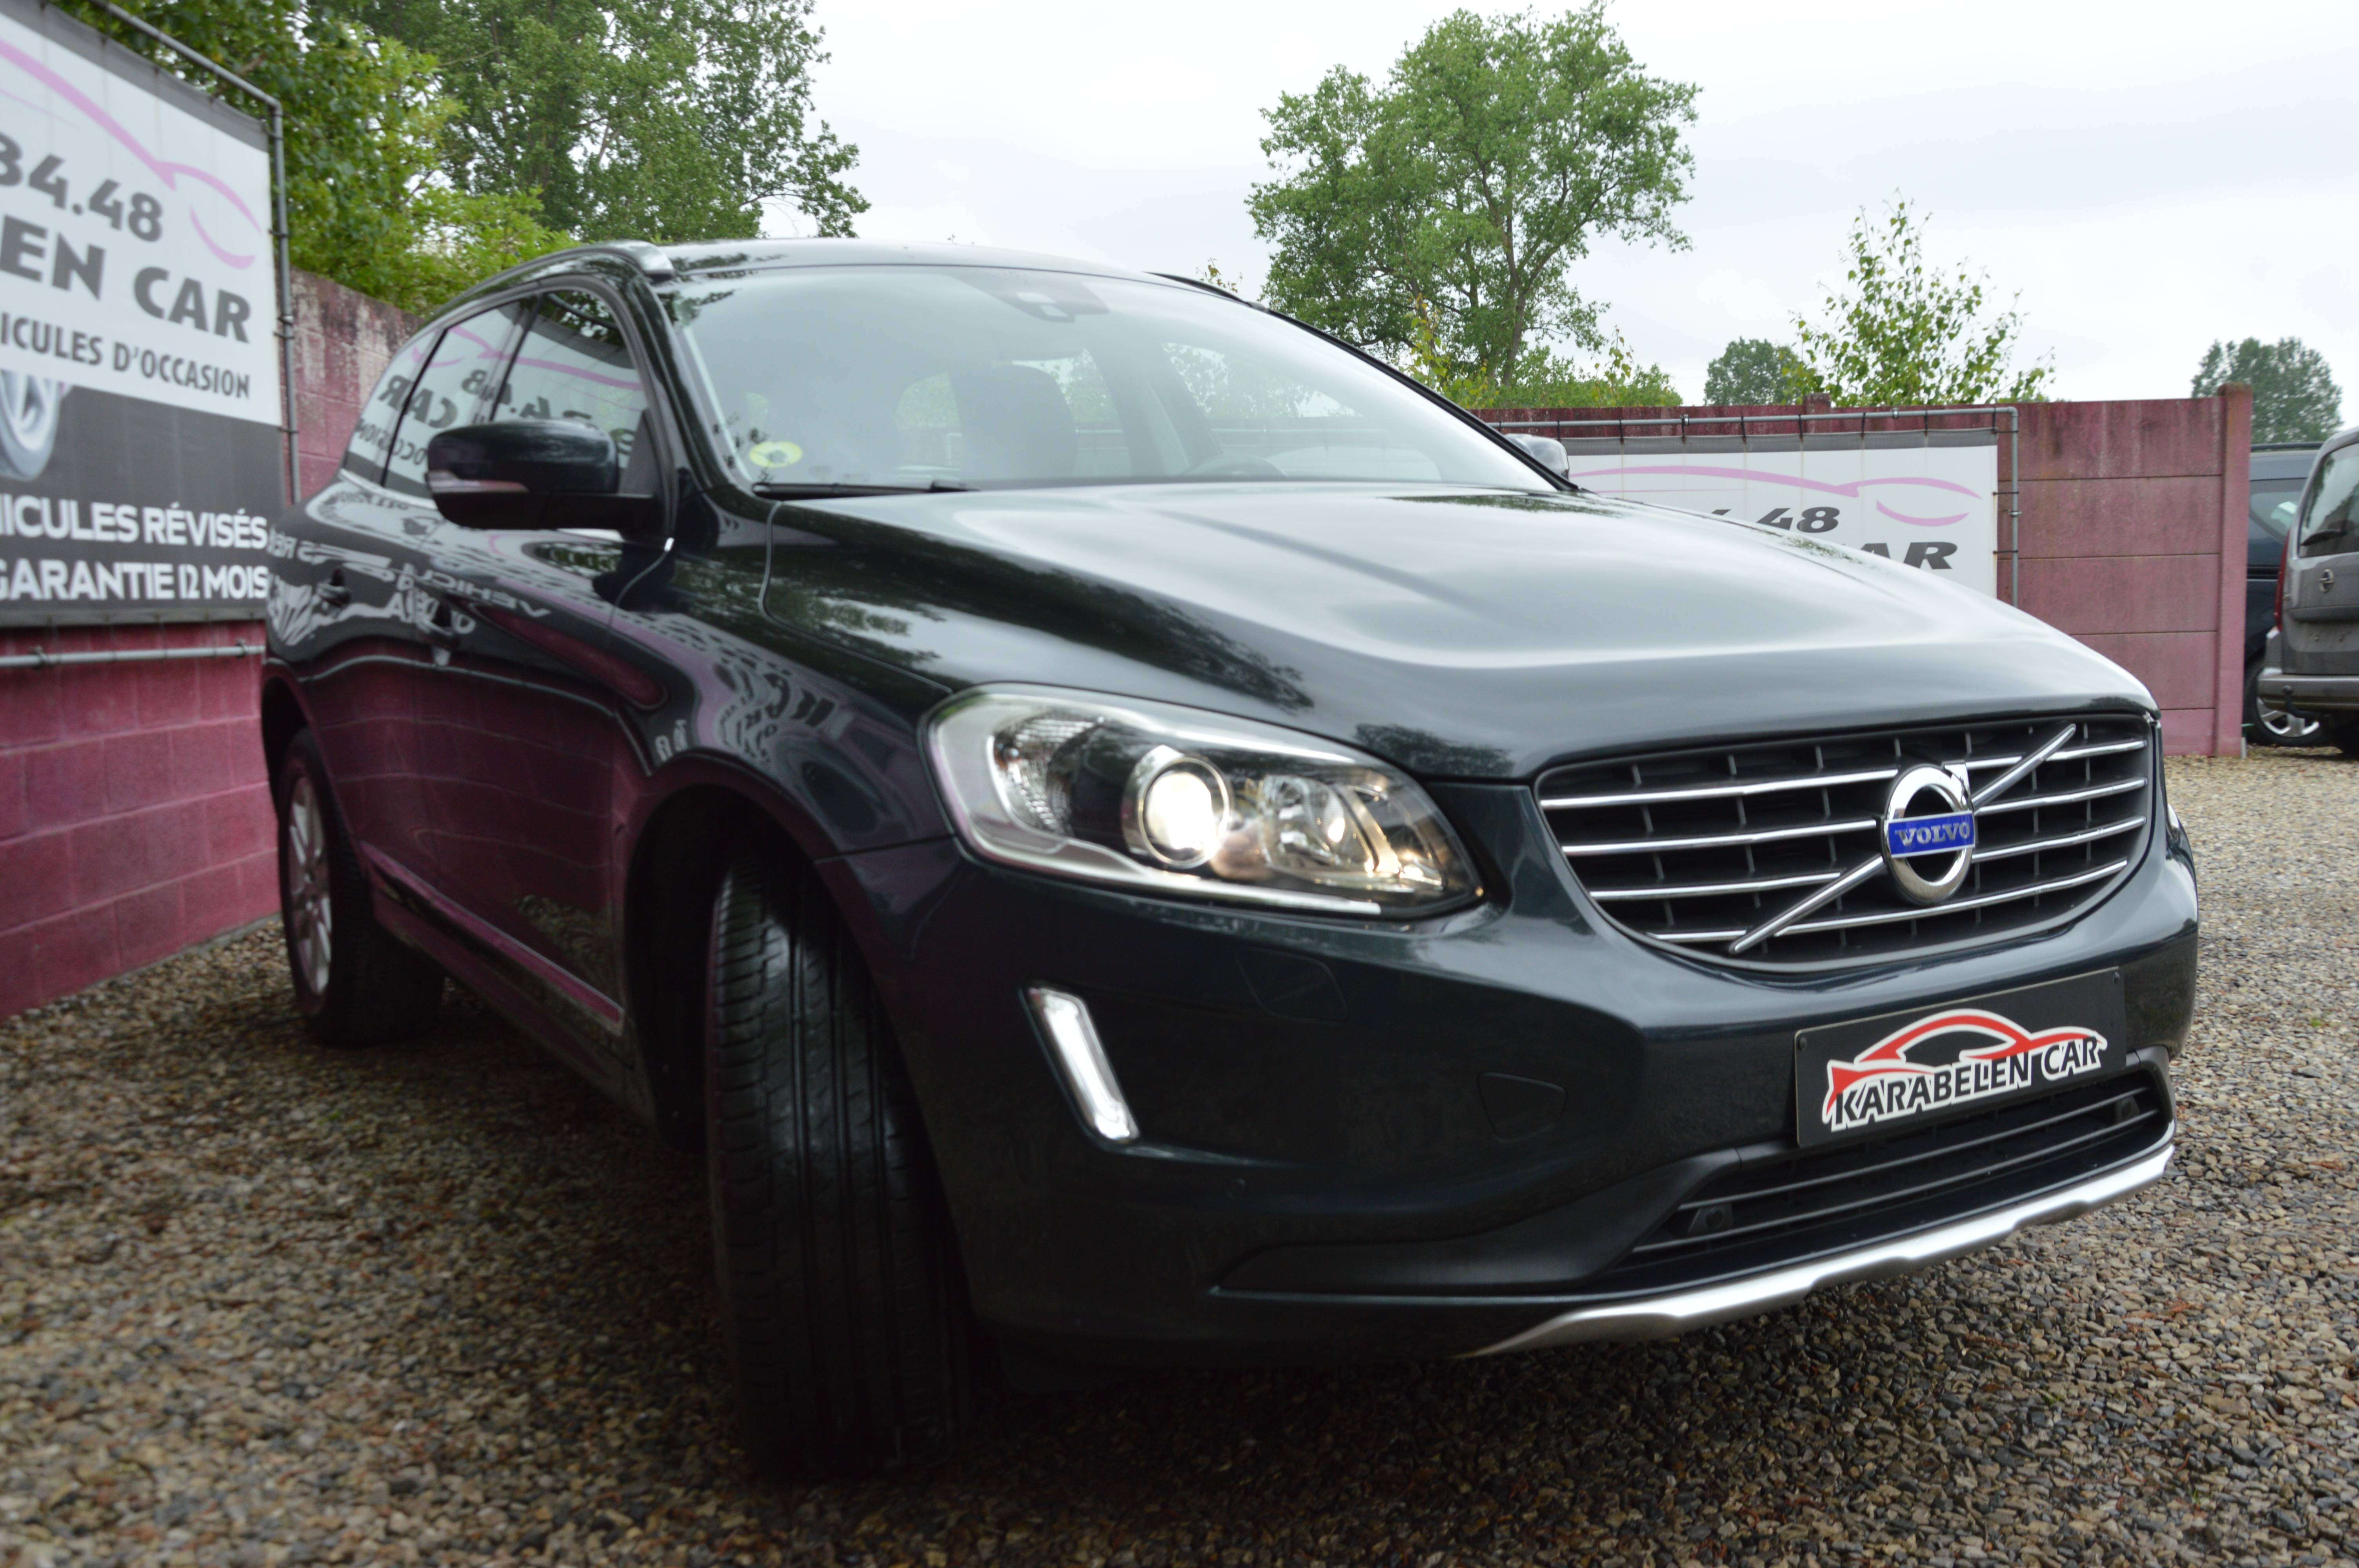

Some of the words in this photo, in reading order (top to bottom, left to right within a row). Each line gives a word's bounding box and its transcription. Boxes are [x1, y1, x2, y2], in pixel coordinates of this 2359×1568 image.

[0, 214, 106, 301] EN
[133, 267, 251, 344] CAR
[113, 342, 250, 399] D'OCCASION
[0, 494, 139, 543] ICULES
[142, 502, 268, 549] RÉVISÉS
[203, 565, 269, 600] MOIS
[1895, 822, 1970, 847] VOLVO
[1833, 1051, 2030, 1127] KARABELEN
[2043, 1036, 2100, 1075] CAR
